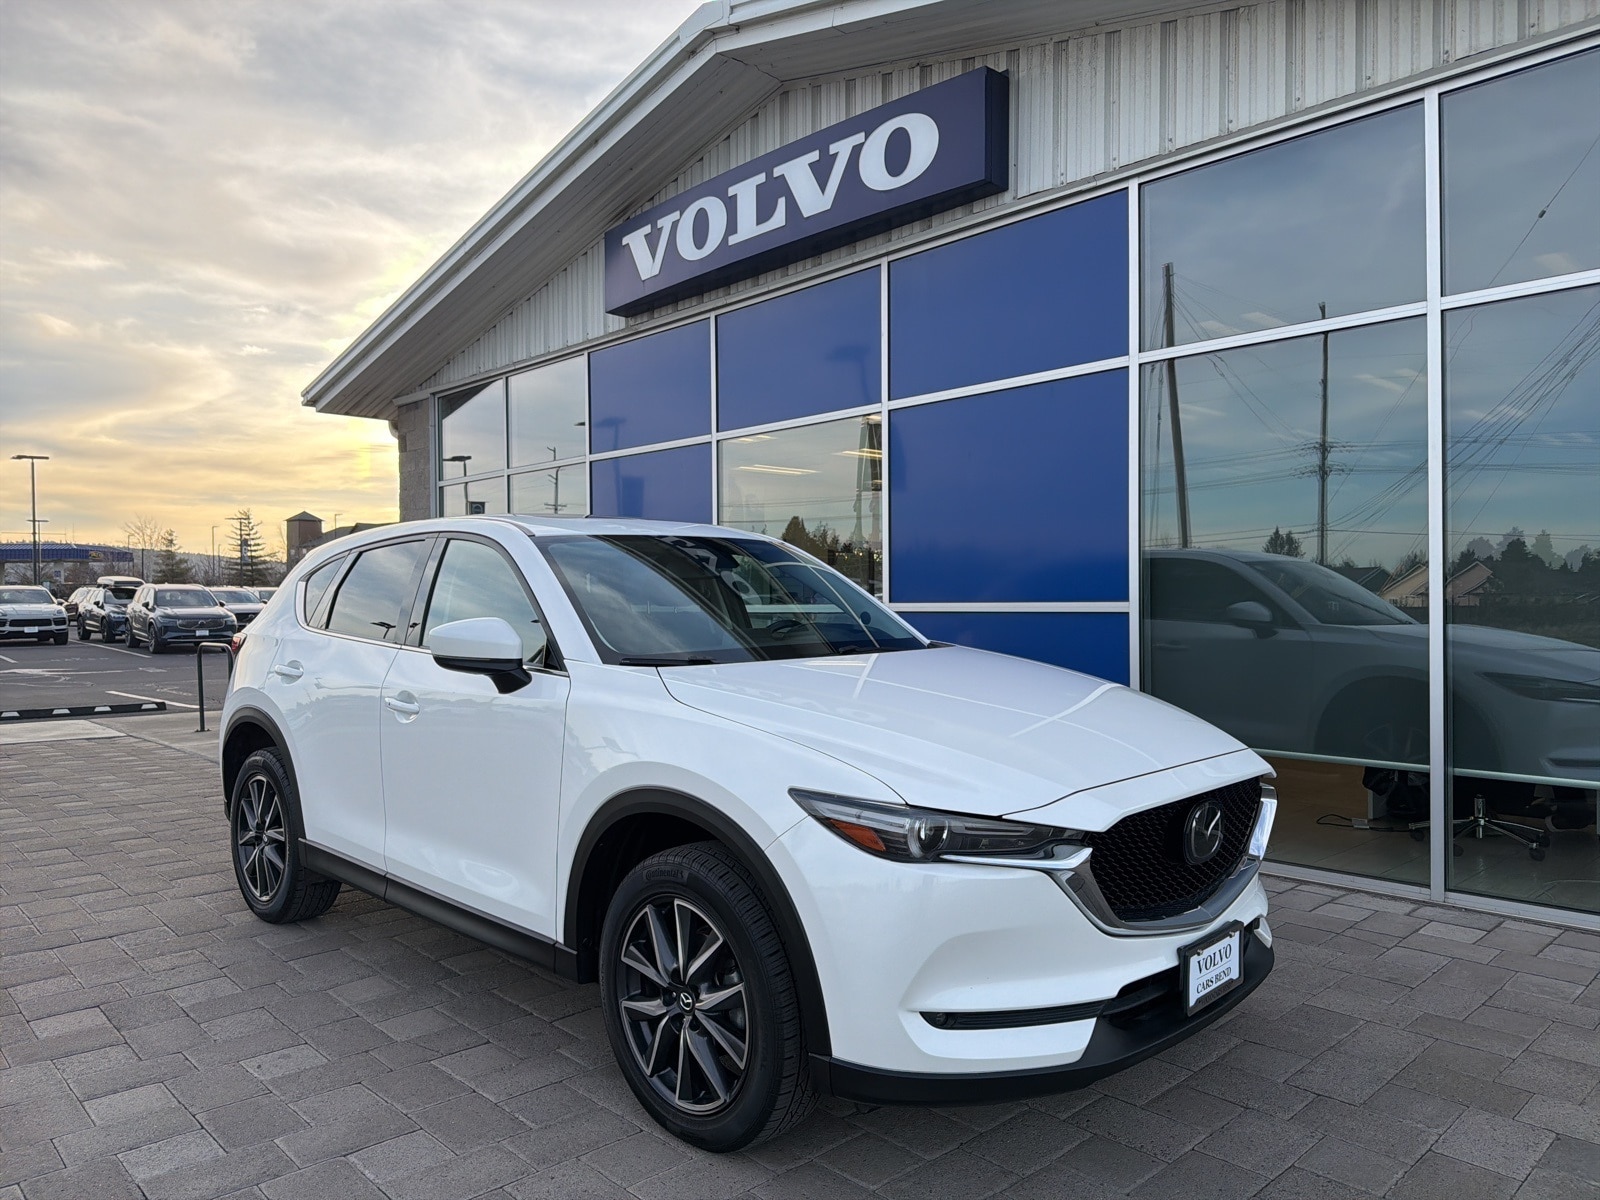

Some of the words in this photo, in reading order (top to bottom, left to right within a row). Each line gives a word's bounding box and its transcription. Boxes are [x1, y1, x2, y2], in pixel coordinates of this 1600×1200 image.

[622, 112, 940, 281] VOLVO
[1197, 943, 1232, 974] VOLVO
[1196, 976, 1214, 994] CARS
[1214, 966, 1232, 986] BEND
